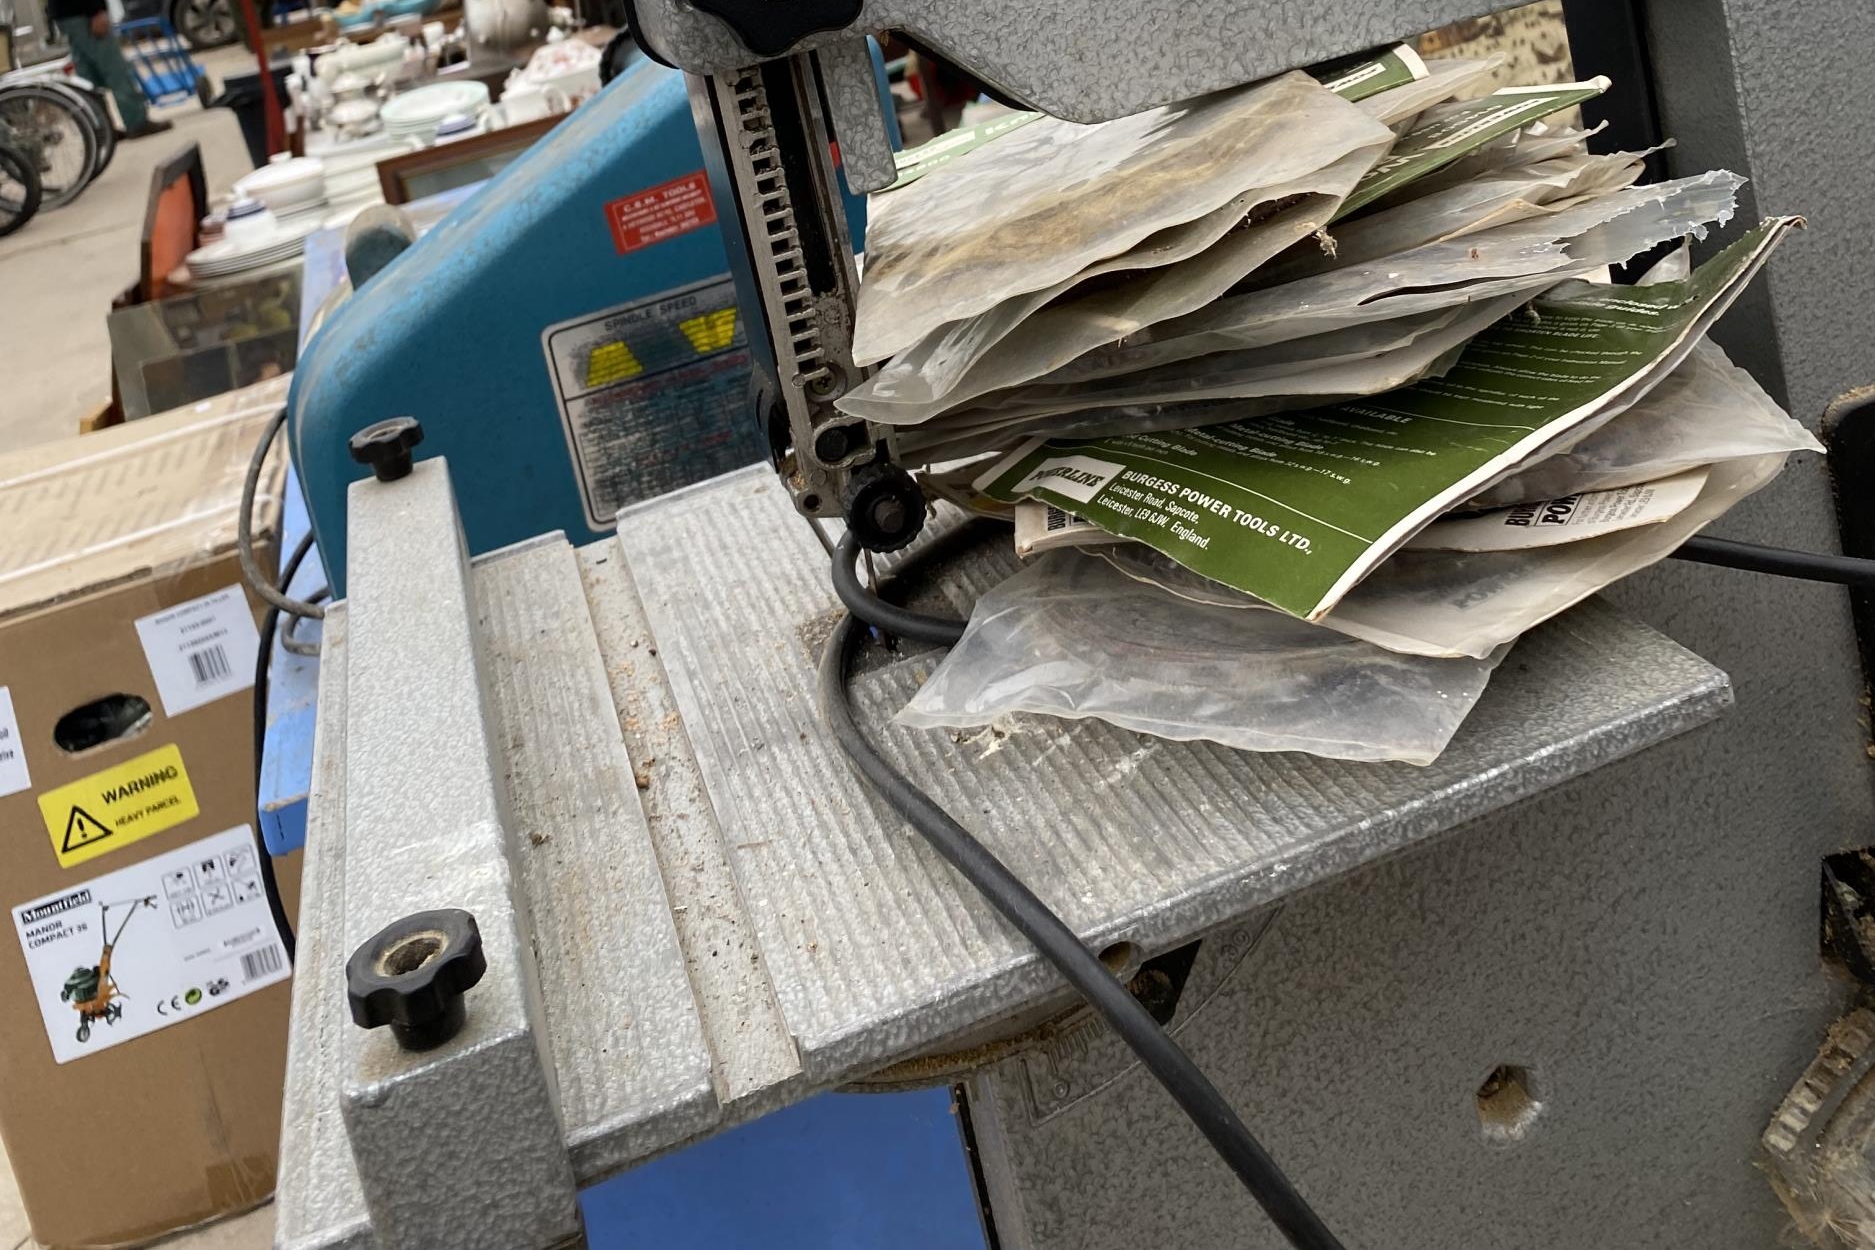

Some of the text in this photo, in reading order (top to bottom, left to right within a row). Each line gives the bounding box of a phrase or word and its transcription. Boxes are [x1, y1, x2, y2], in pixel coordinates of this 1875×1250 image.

[604, 296, 697, 331] SPINDLE SPEED
[1341, 406, 1413, 424] AVAILABLE
[1108, 482, 1148, 501] Leicester
[1164, 500, 1201, 524] Sapcote,
[1121, 470, 1313, 555] BURGESS POWER TOOLS LTD.,
[1096, 494, 1135, 517] Leicester,
[1134, 507, 1151, 521] LE9
[1169, 520, 1211, 550] England.
[102, 765, 178, 805] WARNING
[116, 810, 144, 827] HEAVY
[23, 890, 91, 924] Mountfield
[26, 920, 63, 939] MANOR
[28, 926, 74, 949] COMPACT
